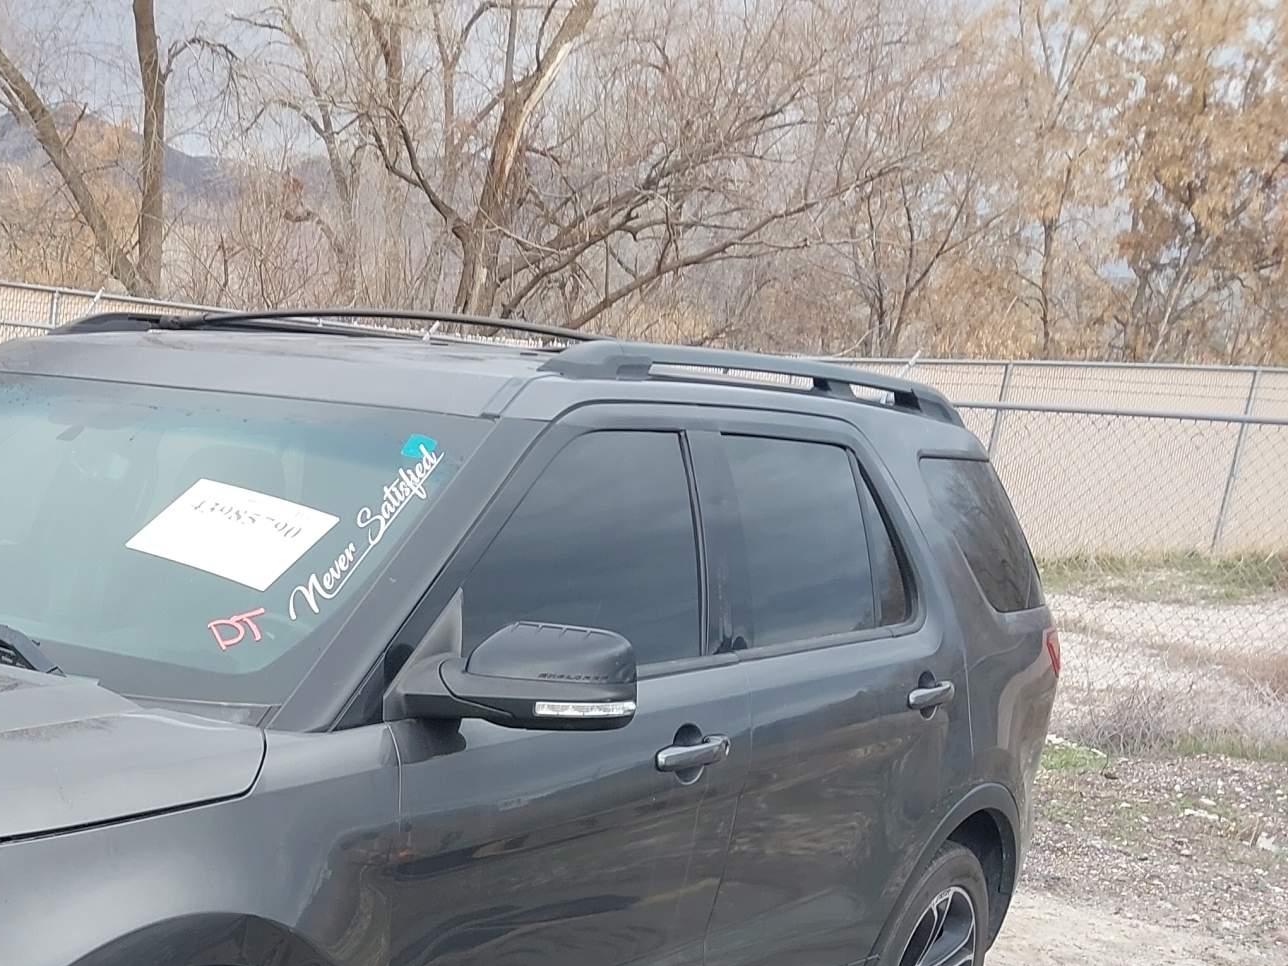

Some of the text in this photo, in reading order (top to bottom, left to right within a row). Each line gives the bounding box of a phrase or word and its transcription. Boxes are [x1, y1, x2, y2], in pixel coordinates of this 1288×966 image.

[288, 443, 444, 621] Never Satisfied
[207, 607, 265, 650] DT
